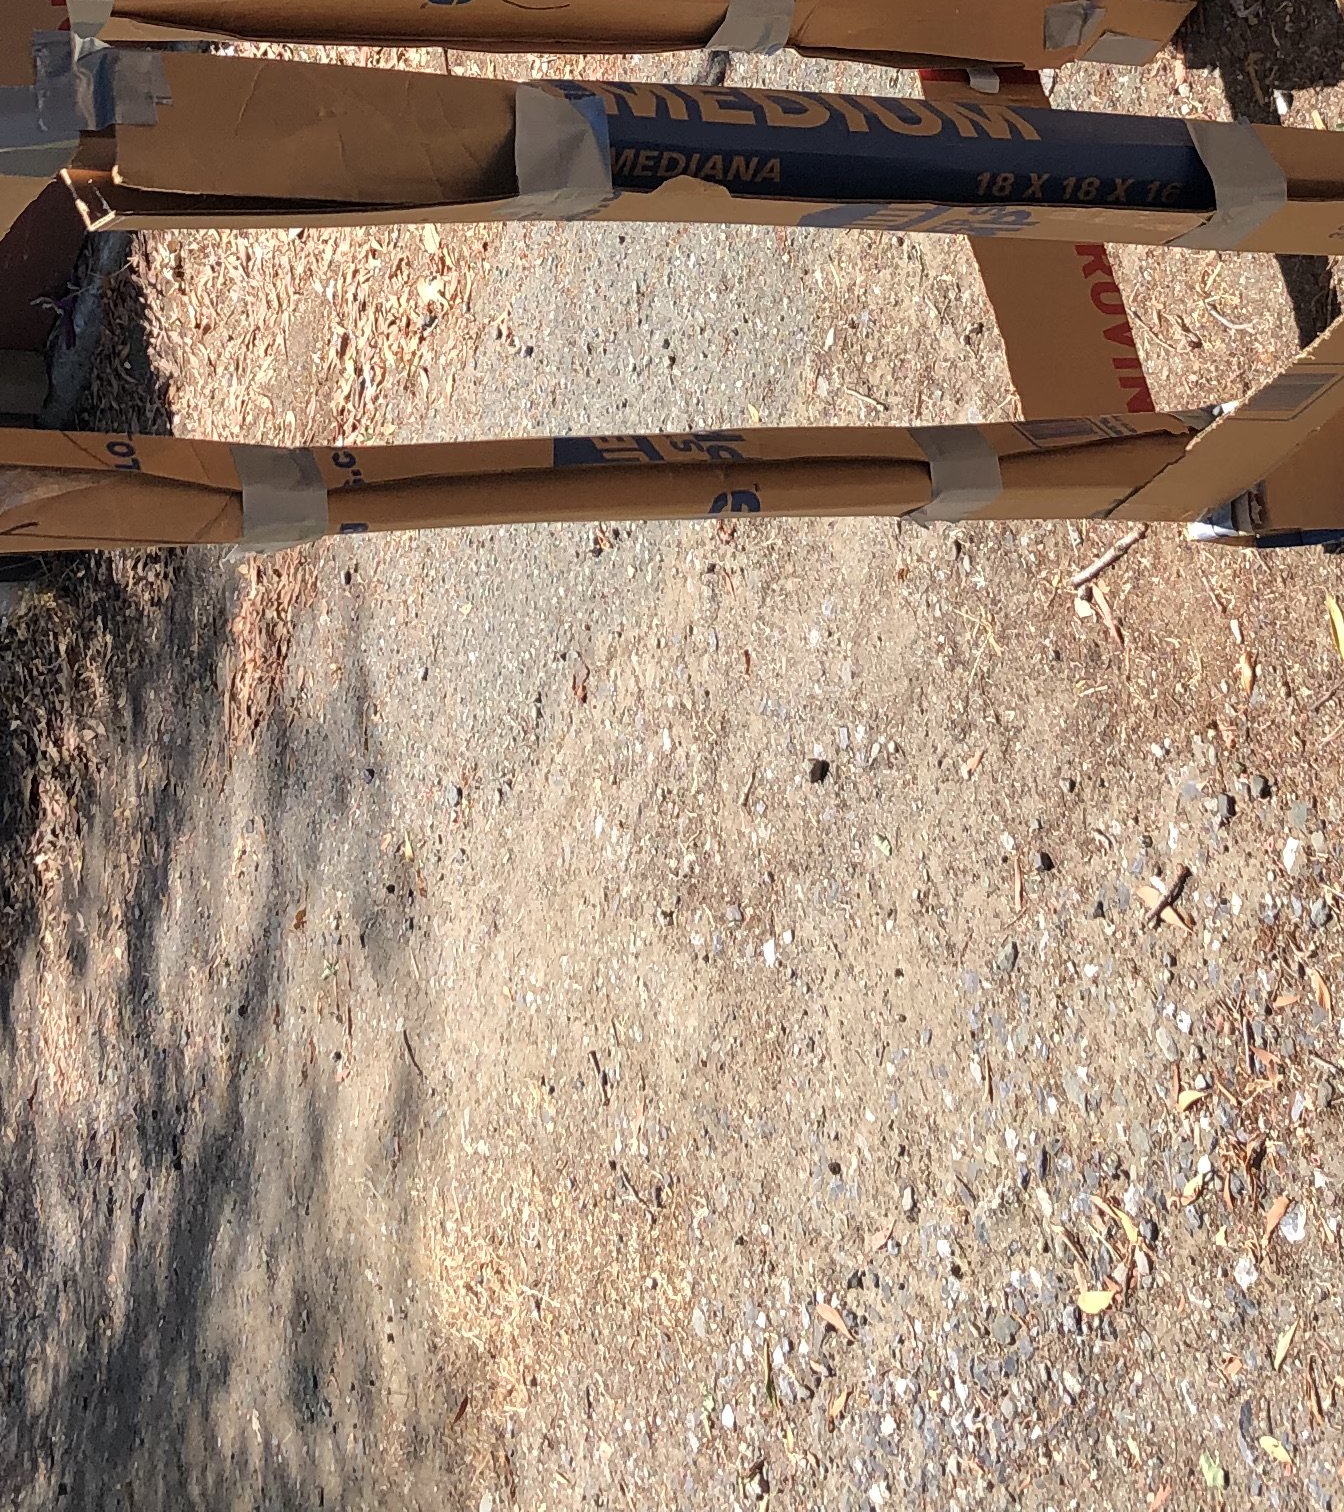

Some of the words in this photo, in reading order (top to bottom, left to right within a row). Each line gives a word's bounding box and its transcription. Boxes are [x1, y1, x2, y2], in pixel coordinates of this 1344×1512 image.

[588, 81, 1042, 141] MEDIUM
[610, 147, 782, 183] MEDIANA
[976, 171, 1016, 198] 18
[1022, 173, 1050, 199] X
[1062, 176, 1101, 202] 18
[1107, 178, 1135, 202] X
[1146, 180, 1183, 204] 16
